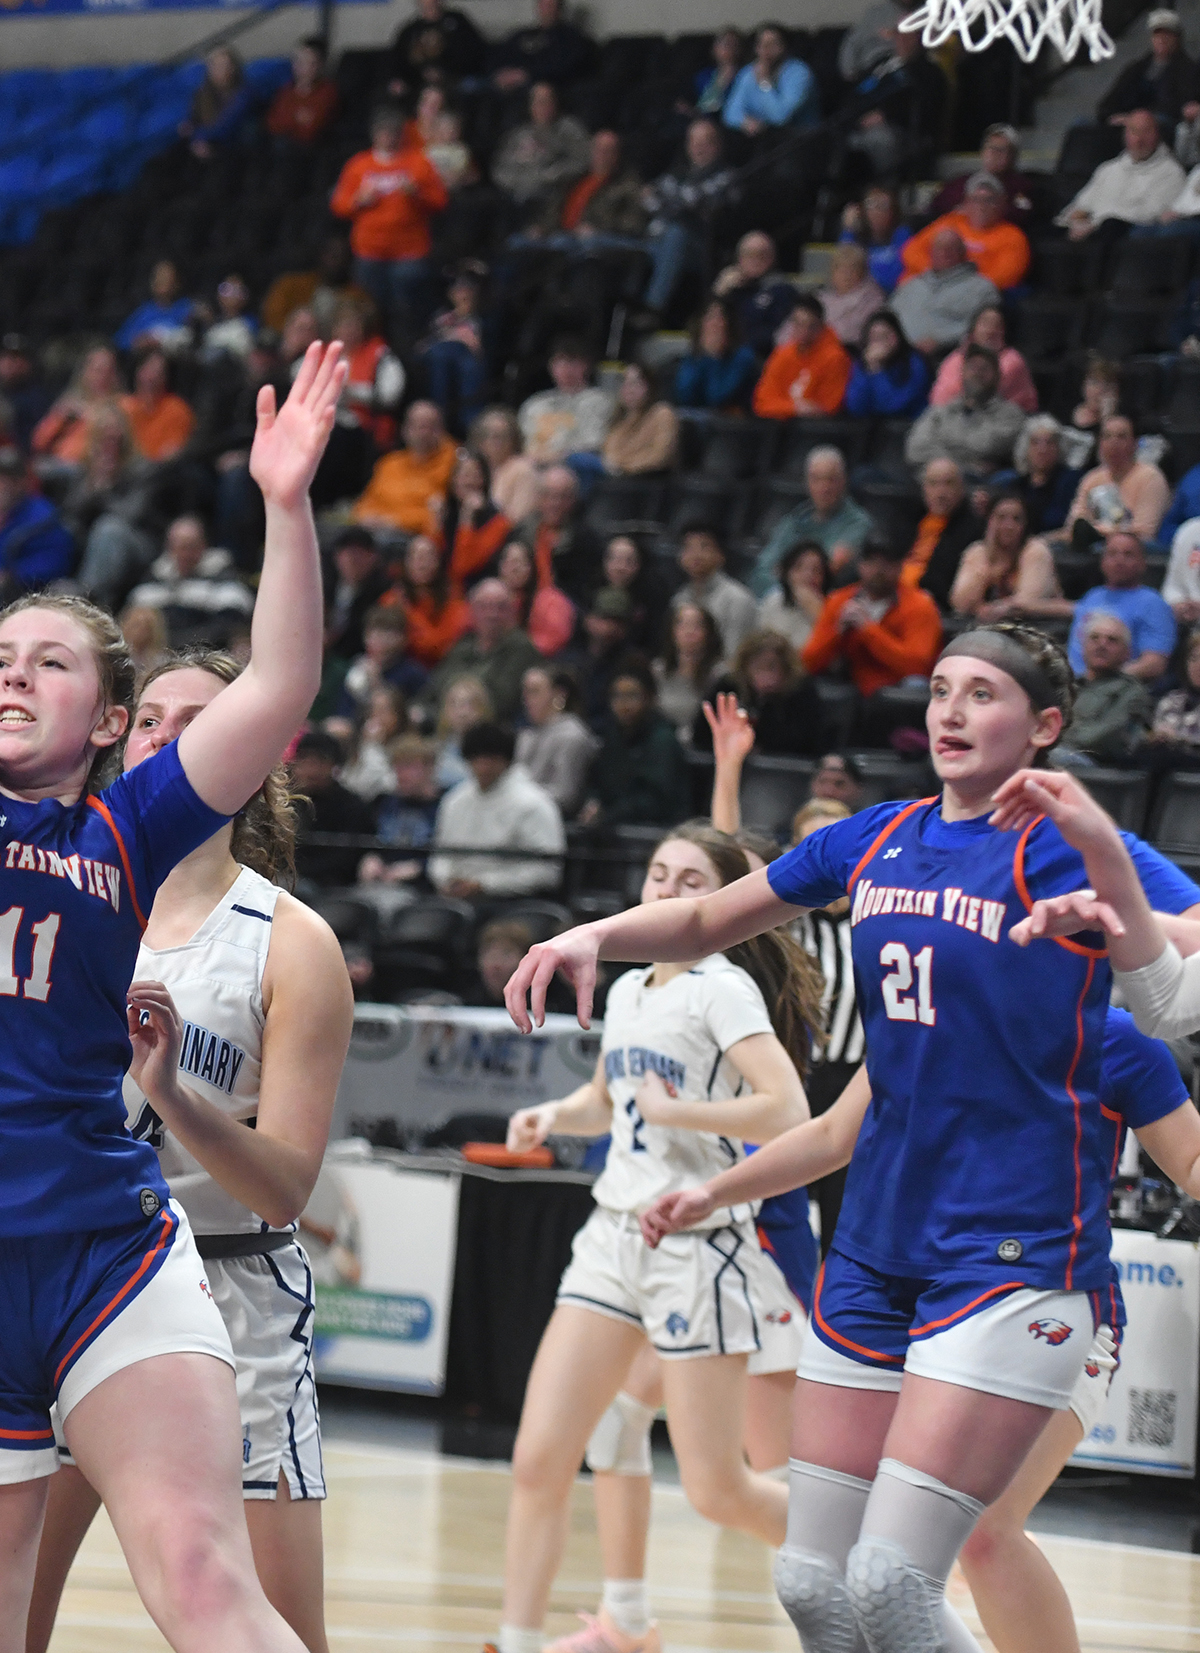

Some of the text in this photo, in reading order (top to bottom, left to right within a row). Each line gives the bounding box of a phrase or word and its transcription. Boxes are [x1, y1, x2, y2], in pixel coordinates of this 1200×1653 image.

[62, 853, 120, 913] VIEW
[851, 879, 1007, 944] MOUNTAIN VIEW
[880, 941, 937, 1026] 21
[625, 1097, 647, 1152] 2
